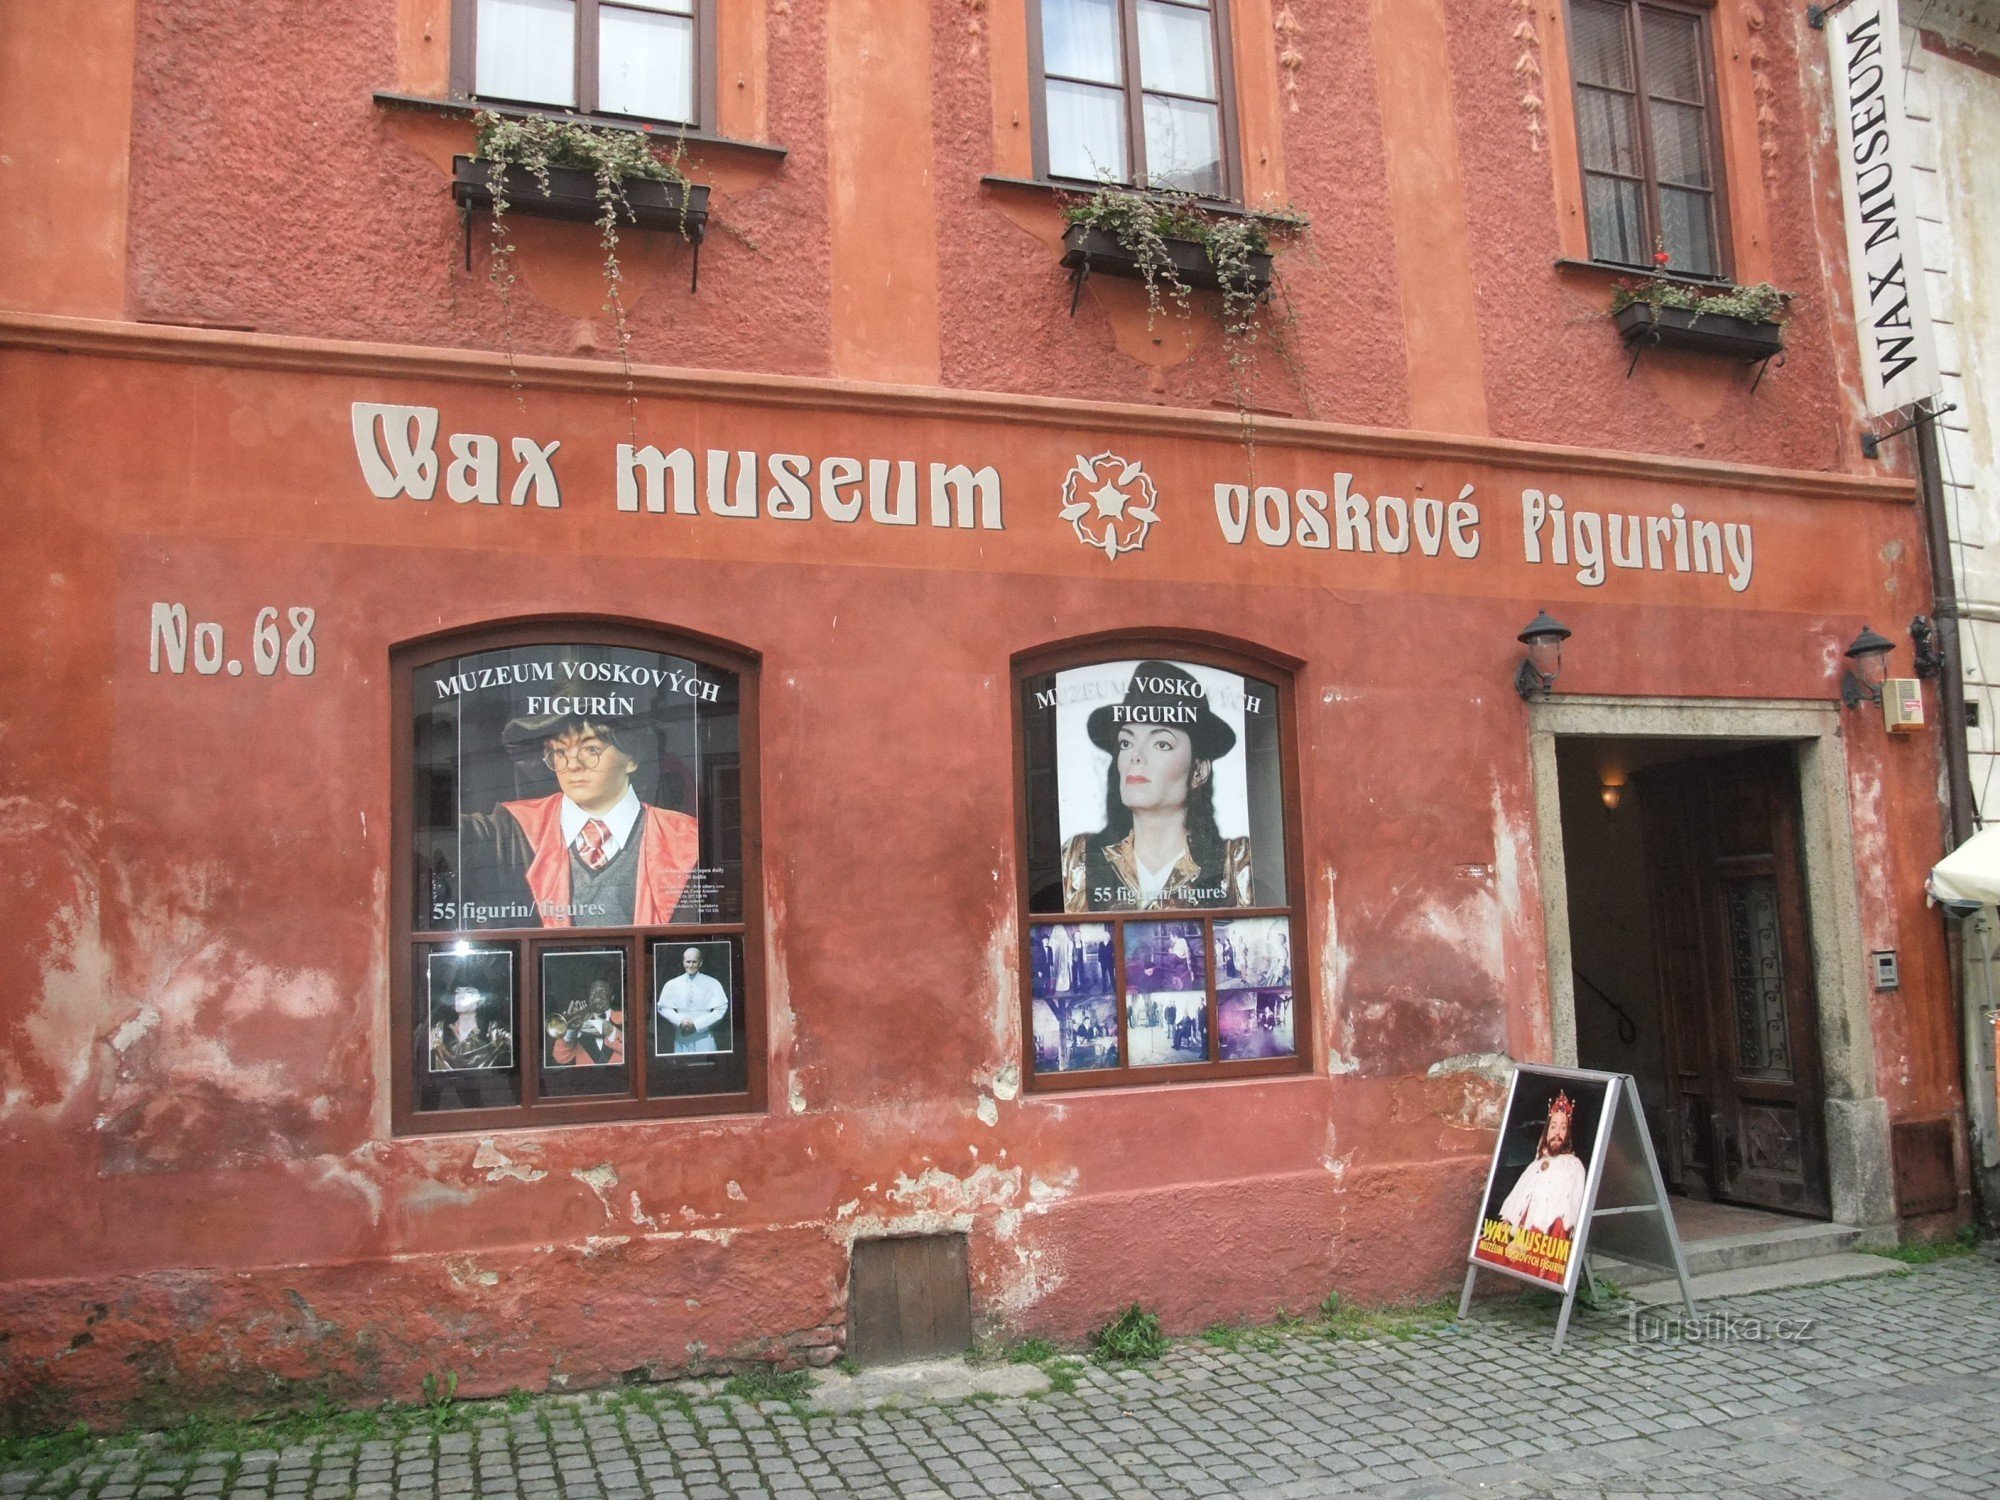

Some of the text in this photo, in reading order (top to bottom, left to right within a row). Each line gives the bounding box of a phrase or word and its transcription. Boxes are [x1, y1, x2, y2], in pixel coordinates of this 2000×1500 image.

[1846, 11, 1919, 388] WAX MUSEUM
[351, 401, 1753, 592] Wax museum voskové figuriny
[253, 606, 316, 676] 68
[434, 661, 721, 703] MUZEUM VOSKOVÝCH
[526, 691, 636, 716] FIGURÍN
[1112, 701, 1199, 723] FIGURÍN
[433, 902, 456, 920] 55
[539, 900, 607, 921] figures
[1093, 886, 1112, 902] 55
[1177, 885, 1228, 906] figures
[1482, 1218, 1571, 1262] WAX MUSEUM
